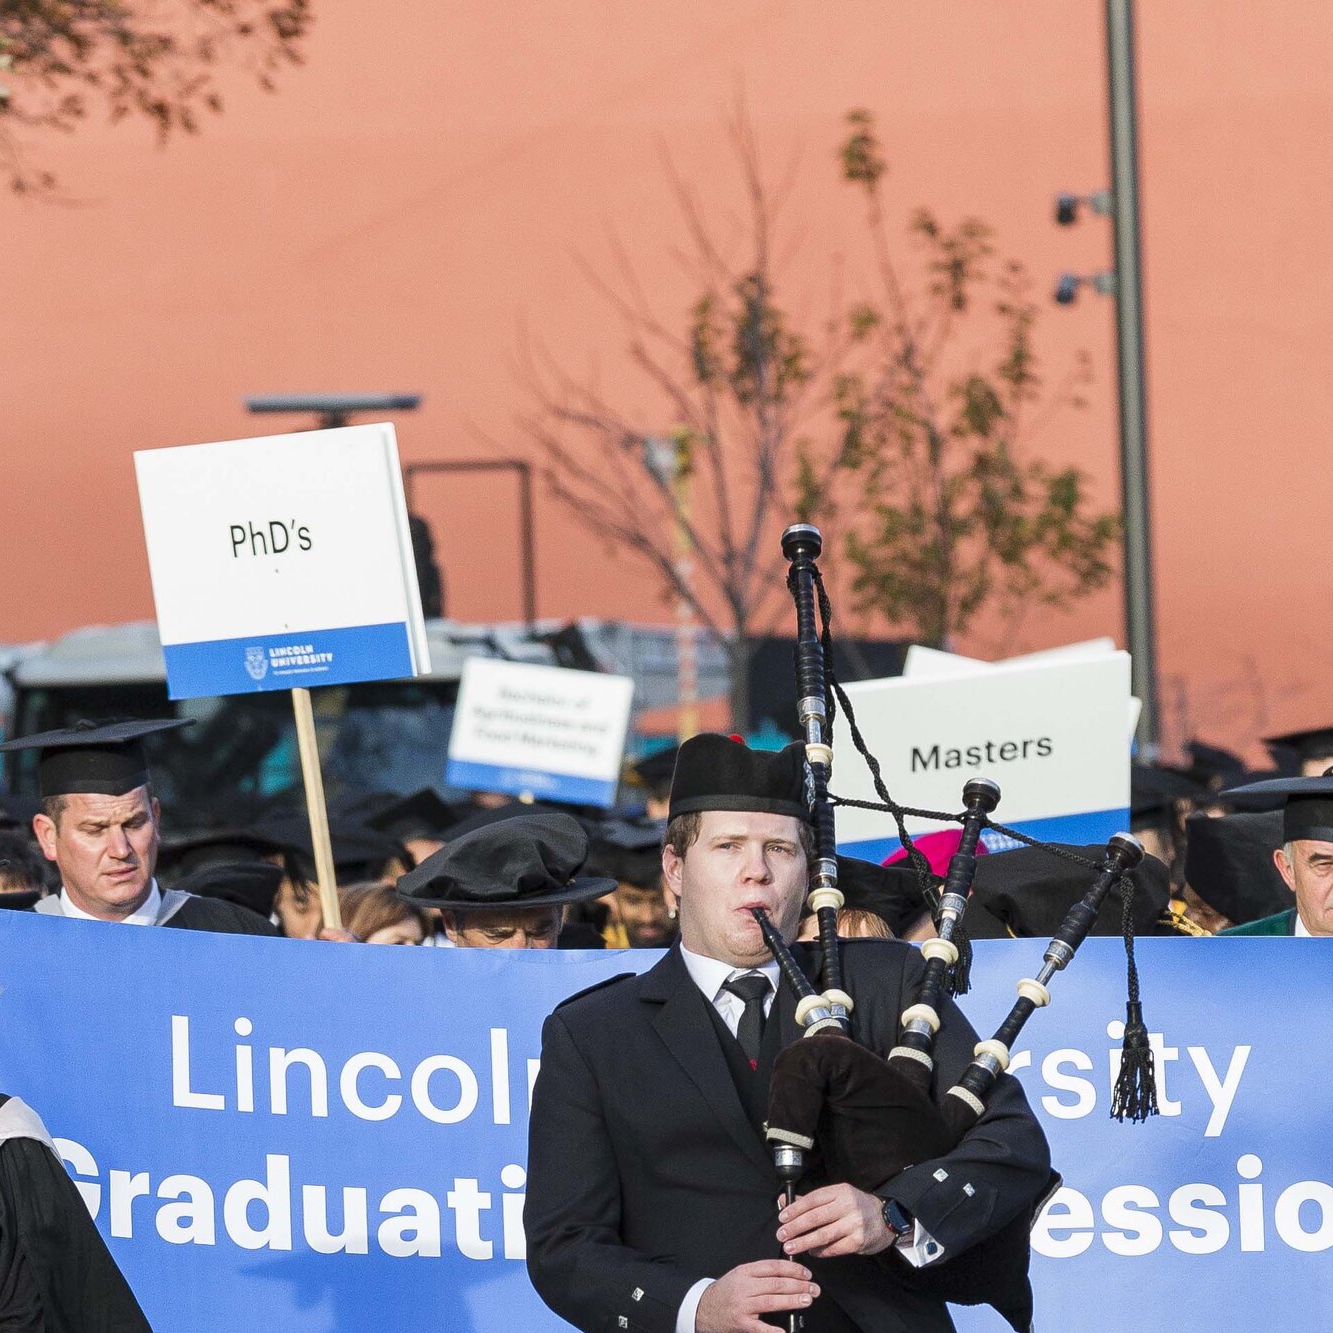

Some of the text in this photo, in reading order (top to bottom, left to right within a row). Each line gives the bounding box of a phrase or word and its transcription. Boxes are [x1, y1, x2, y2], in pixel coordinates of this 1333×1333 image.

[229, 518, 313, 559] PhD's
[269, 644, 314, 658] LINCOLN
[270, 652, 333, 668] UNIVERSITY
[910, 736, 1054, 773] Masters
[172, 1015, 540, 1125] Lincol
[51, 1137, 527, 1261] raduati
